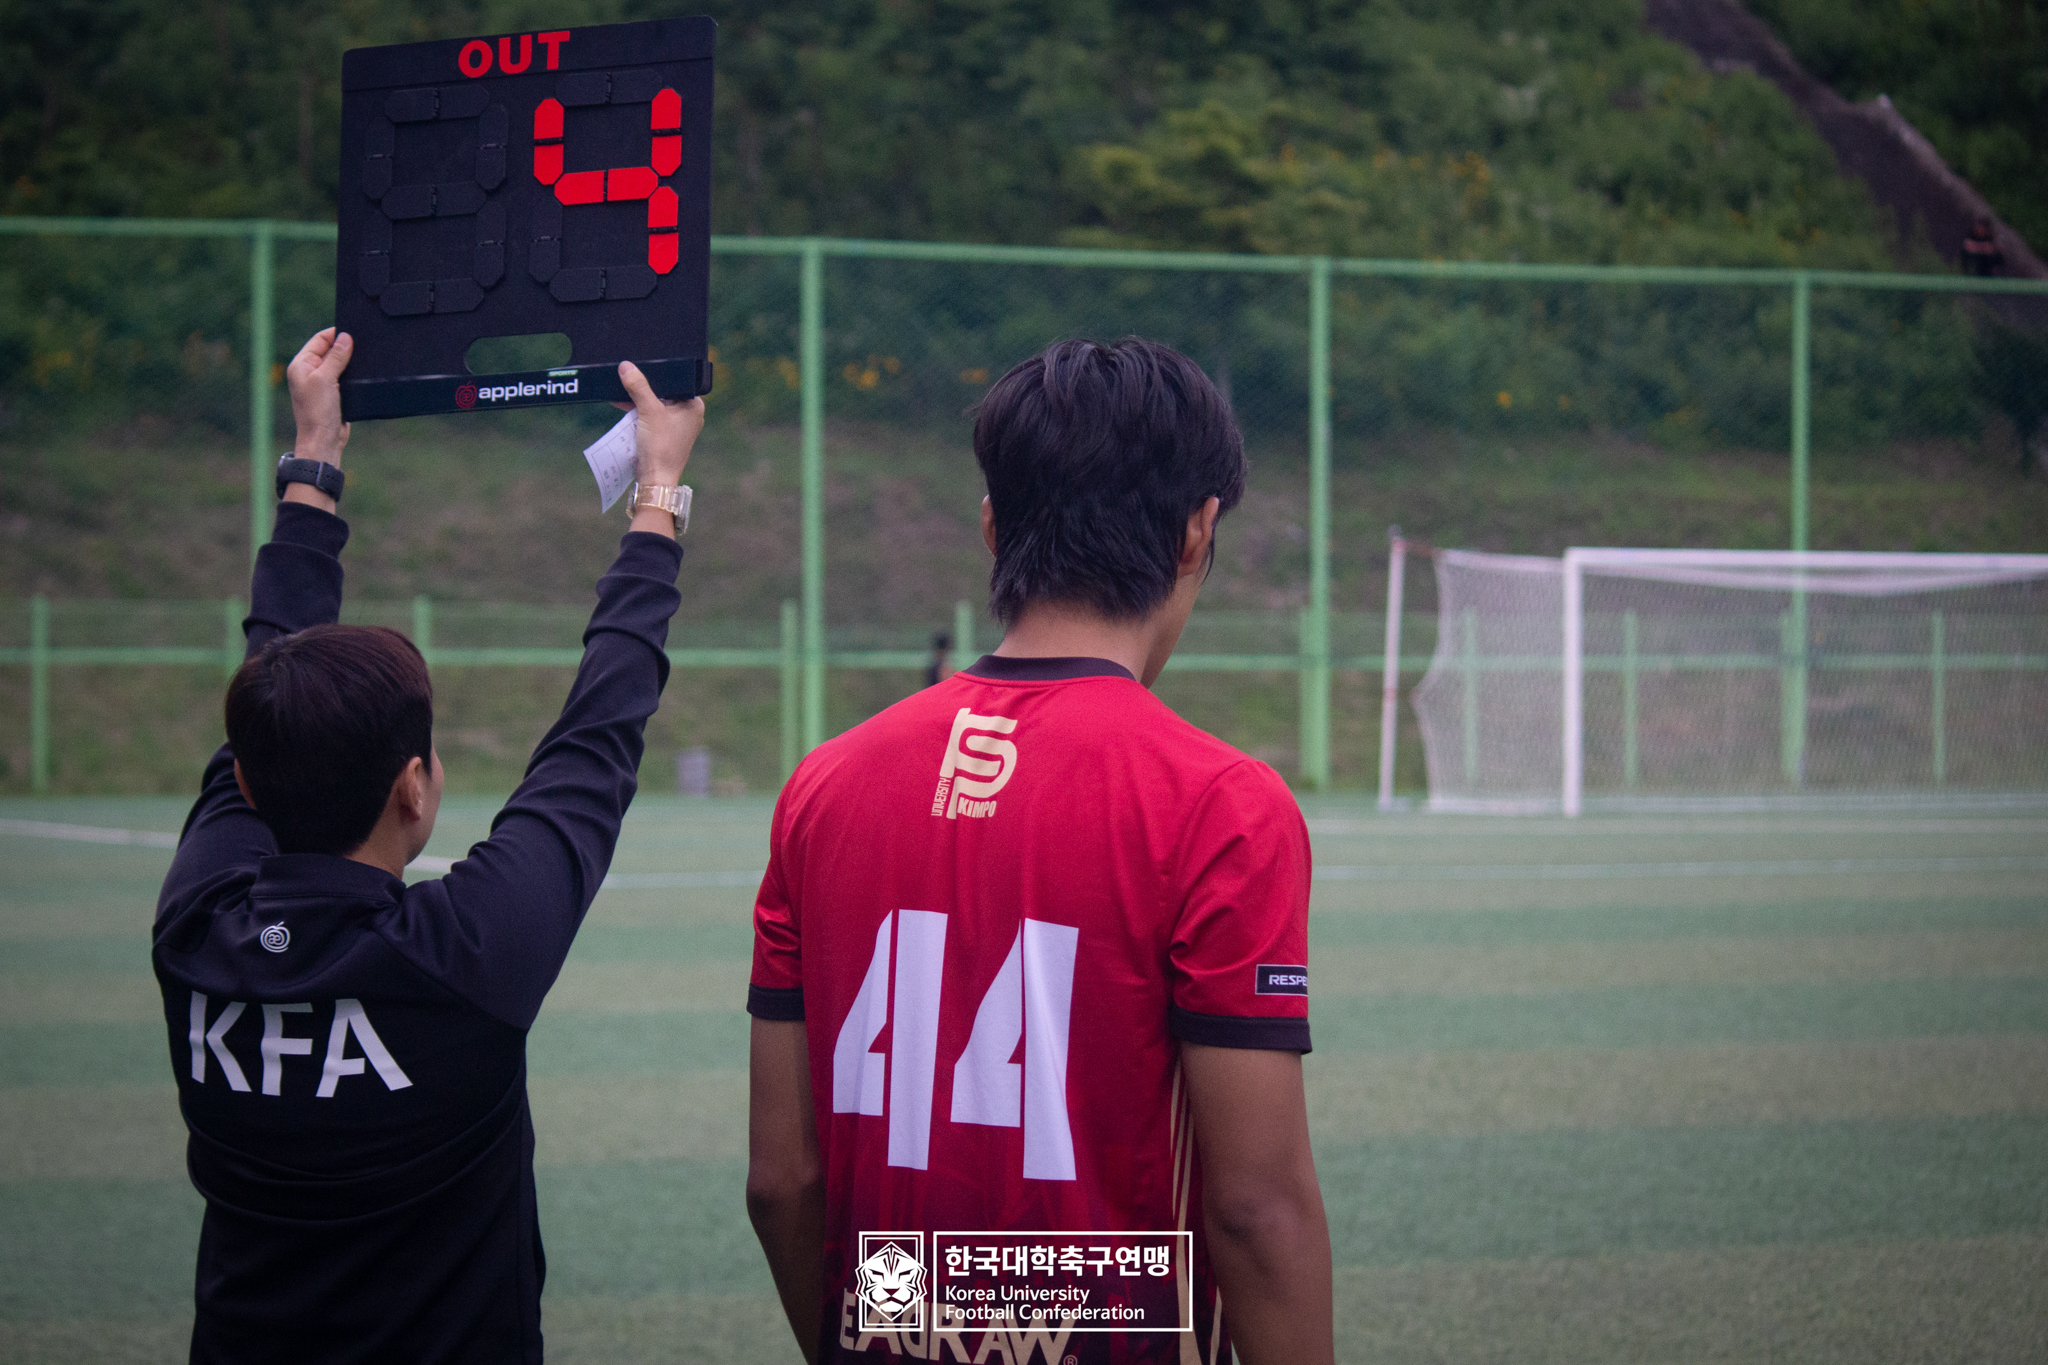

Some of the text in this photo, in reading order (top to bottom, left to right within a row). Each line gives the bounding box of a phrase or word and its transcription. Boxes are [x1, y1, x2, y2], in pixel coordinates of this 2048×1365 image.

[458, 31, 571, 78] OUT
[533, 88, 683, 275] 4
[478, 379, 579, 402] applerind
[957, 796, 997, 818] KIMPO
[188, 990, 414, 1098] KFA
[832, 909, 1079, 1181] 44
